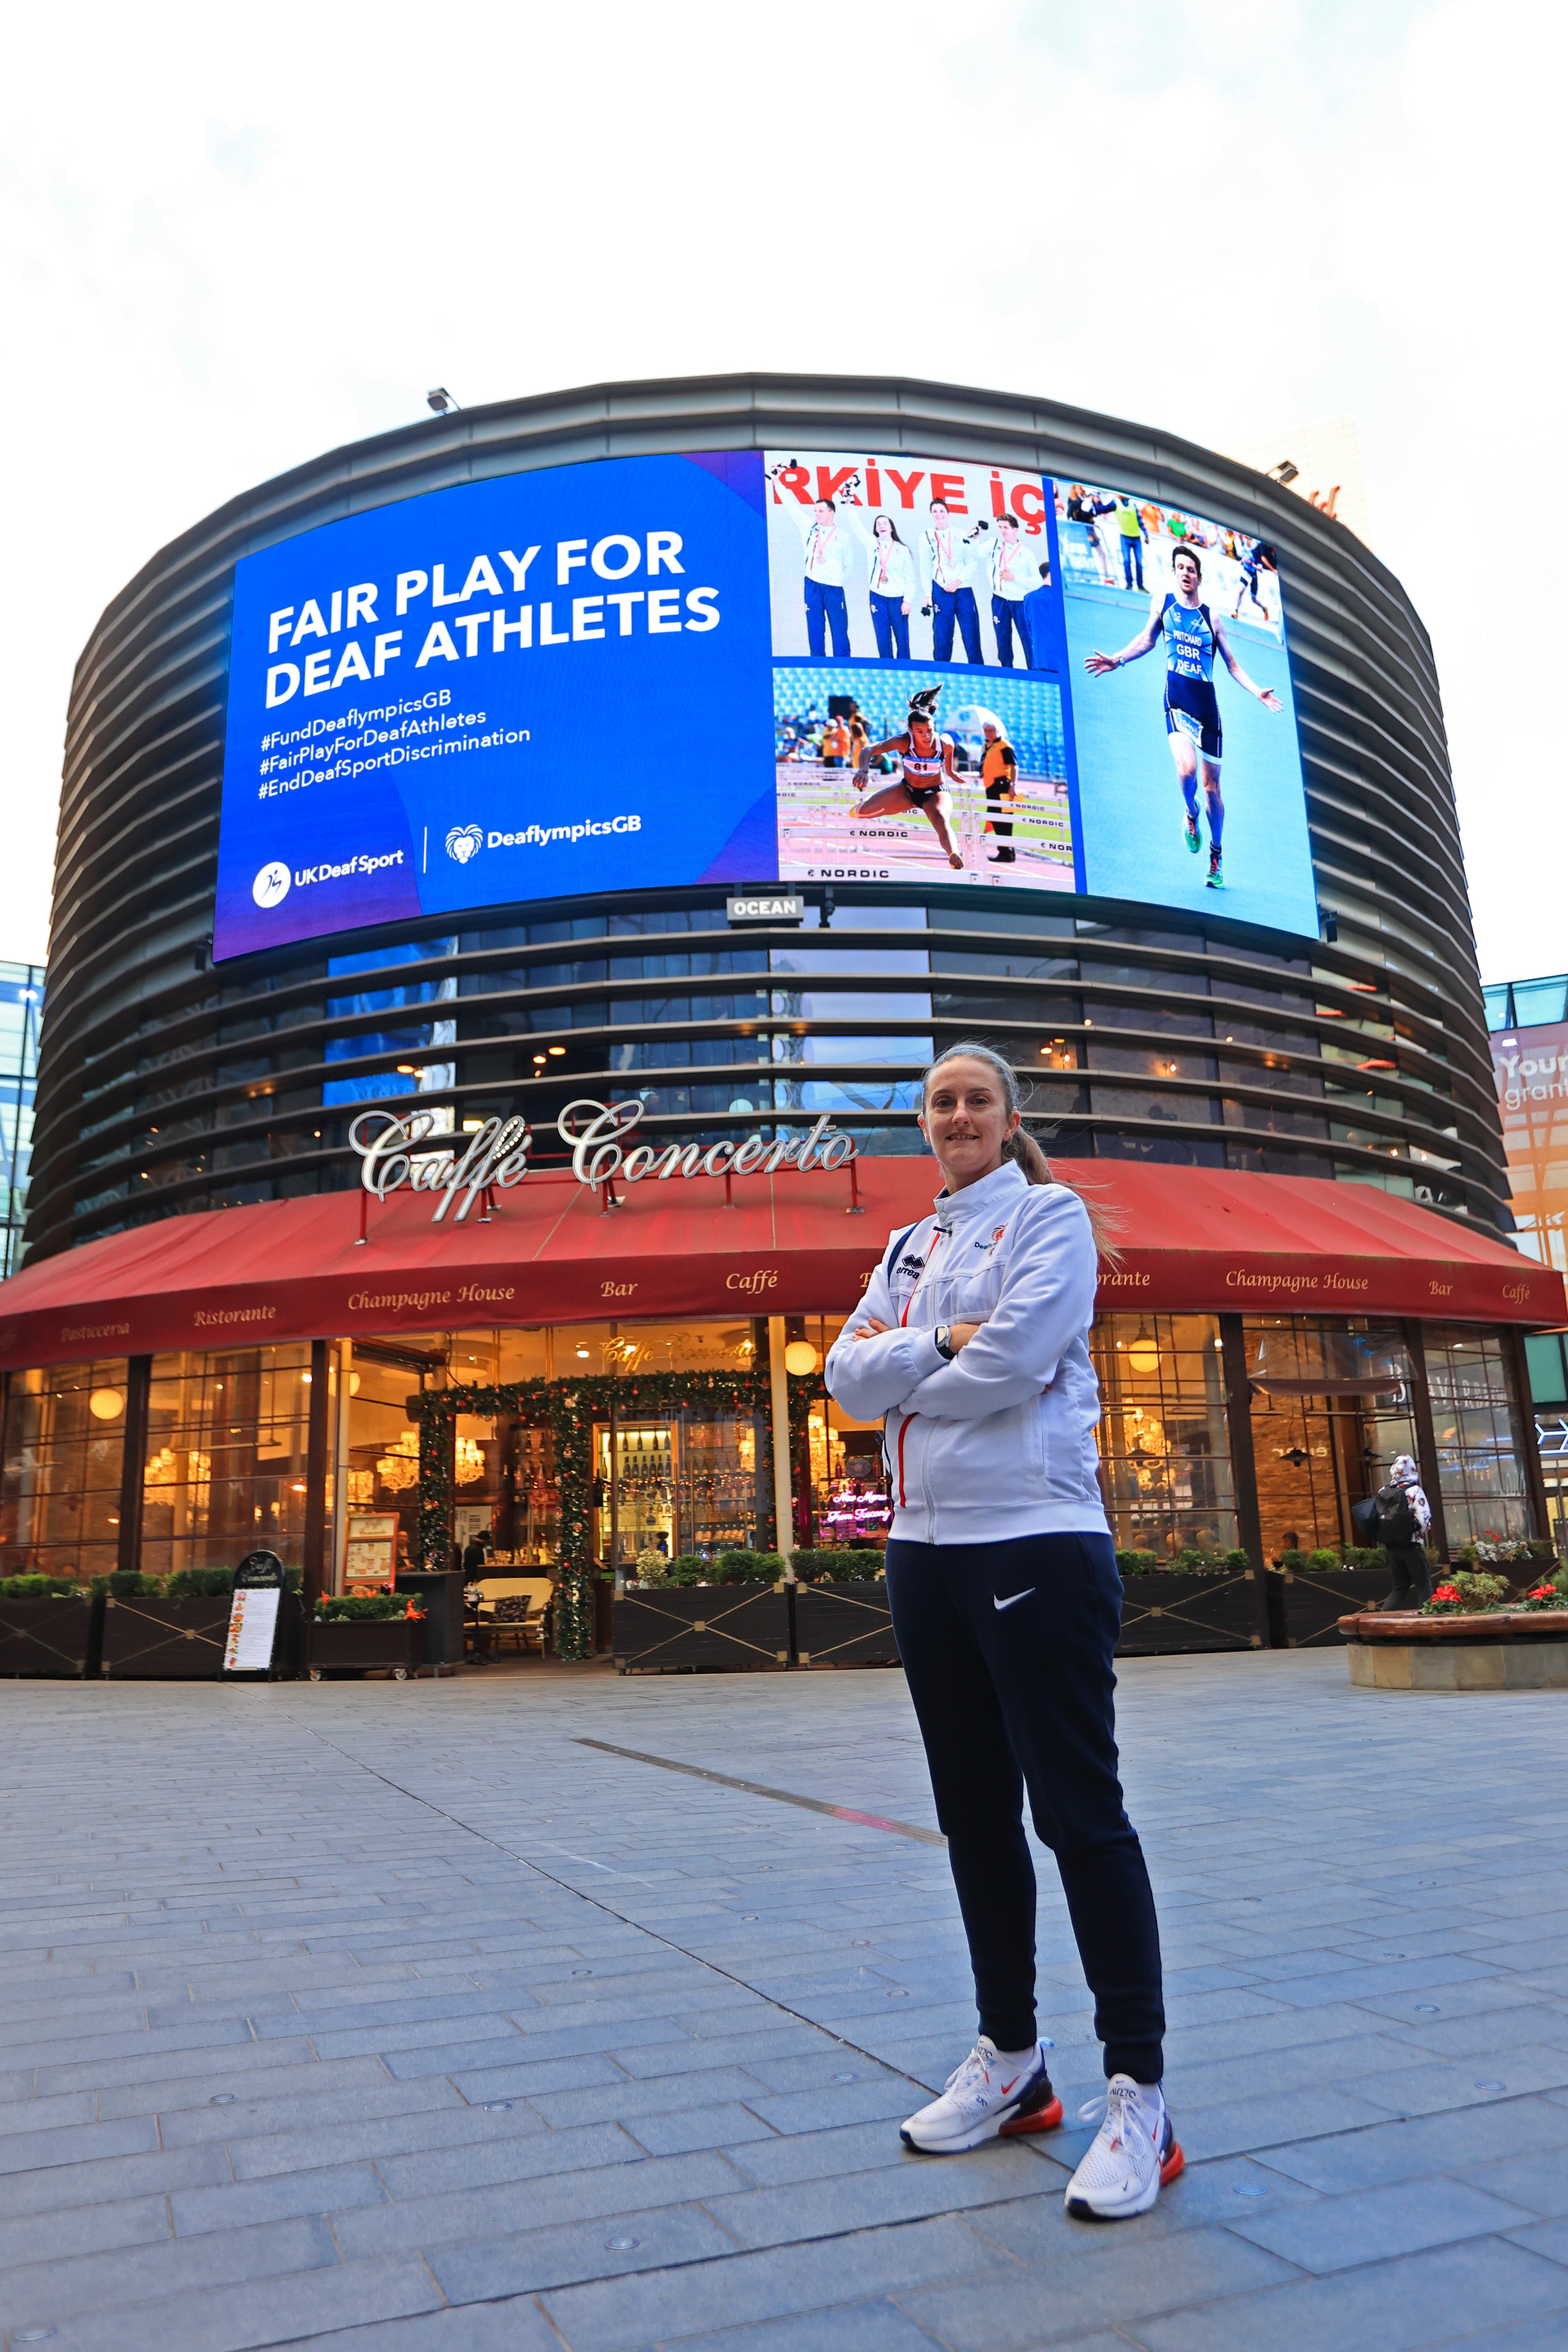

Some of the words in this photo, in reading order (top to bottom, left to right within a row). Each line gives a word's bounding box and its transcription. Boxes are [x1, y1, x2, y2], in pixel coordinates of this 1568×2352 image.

[269, 583, 378, 653] FAIR
[396, 546, 541, 615] PLAY
[557, 531, 685, 585] FOR
[266, 630, 402, 709] DEAF
[415, 587, 720, 668] ATHLETES
[1173, 630, 1202, 647] PRITCHARD
[1176, 644, 1200, 661] GBR
[1177, 659, 1202, 674] DEAF
[261, 689, 451, 751] #FundDeaflympicsGB
[260, 713, 486, 775] #FairPlayForDeafAthletes
[259, 729, 530, 799] #EndDeafSportDiscrimination
[914, 763, 927, 771] 81
[488, 816, 641, 848] DeaflympicsGB
[1029, 819, 1064, 827] NORDIC
[821, 869, 889, 878] NORDIC
[734, 900, 797, 916] OCEAN
[1498, 1055, 1568, 1078] Your
[348, 1110, 532, 1222] Caffé
[557, 1099, 860, 1193] Concerto
[726, 1270, 778, 1295] Caffé
[896, 1267, 920, 1280] errea
[1097, 1271, 1151, 1286] orante
[1226, 1269, 1318, 1293] Champagne
[1323, 1272, 1369, 1290] House
[348, 1291, 451, 1312] Champagne
[456, 1283, 516, 1302] House
[600, 1281, 638, 1297] Bar
[1429, 1281, 1453, 1296] Bar
[1502, 1283, 1530, 1304] Caffé
[193, 1305, 276, 1326] Ristorante
[833, 1490, 856, 1503] New
[857, 1491, 887, 1503] Menu
[827, 1511, 853, 1522] From
[854, 1508, 891, 1522] Tuscany
